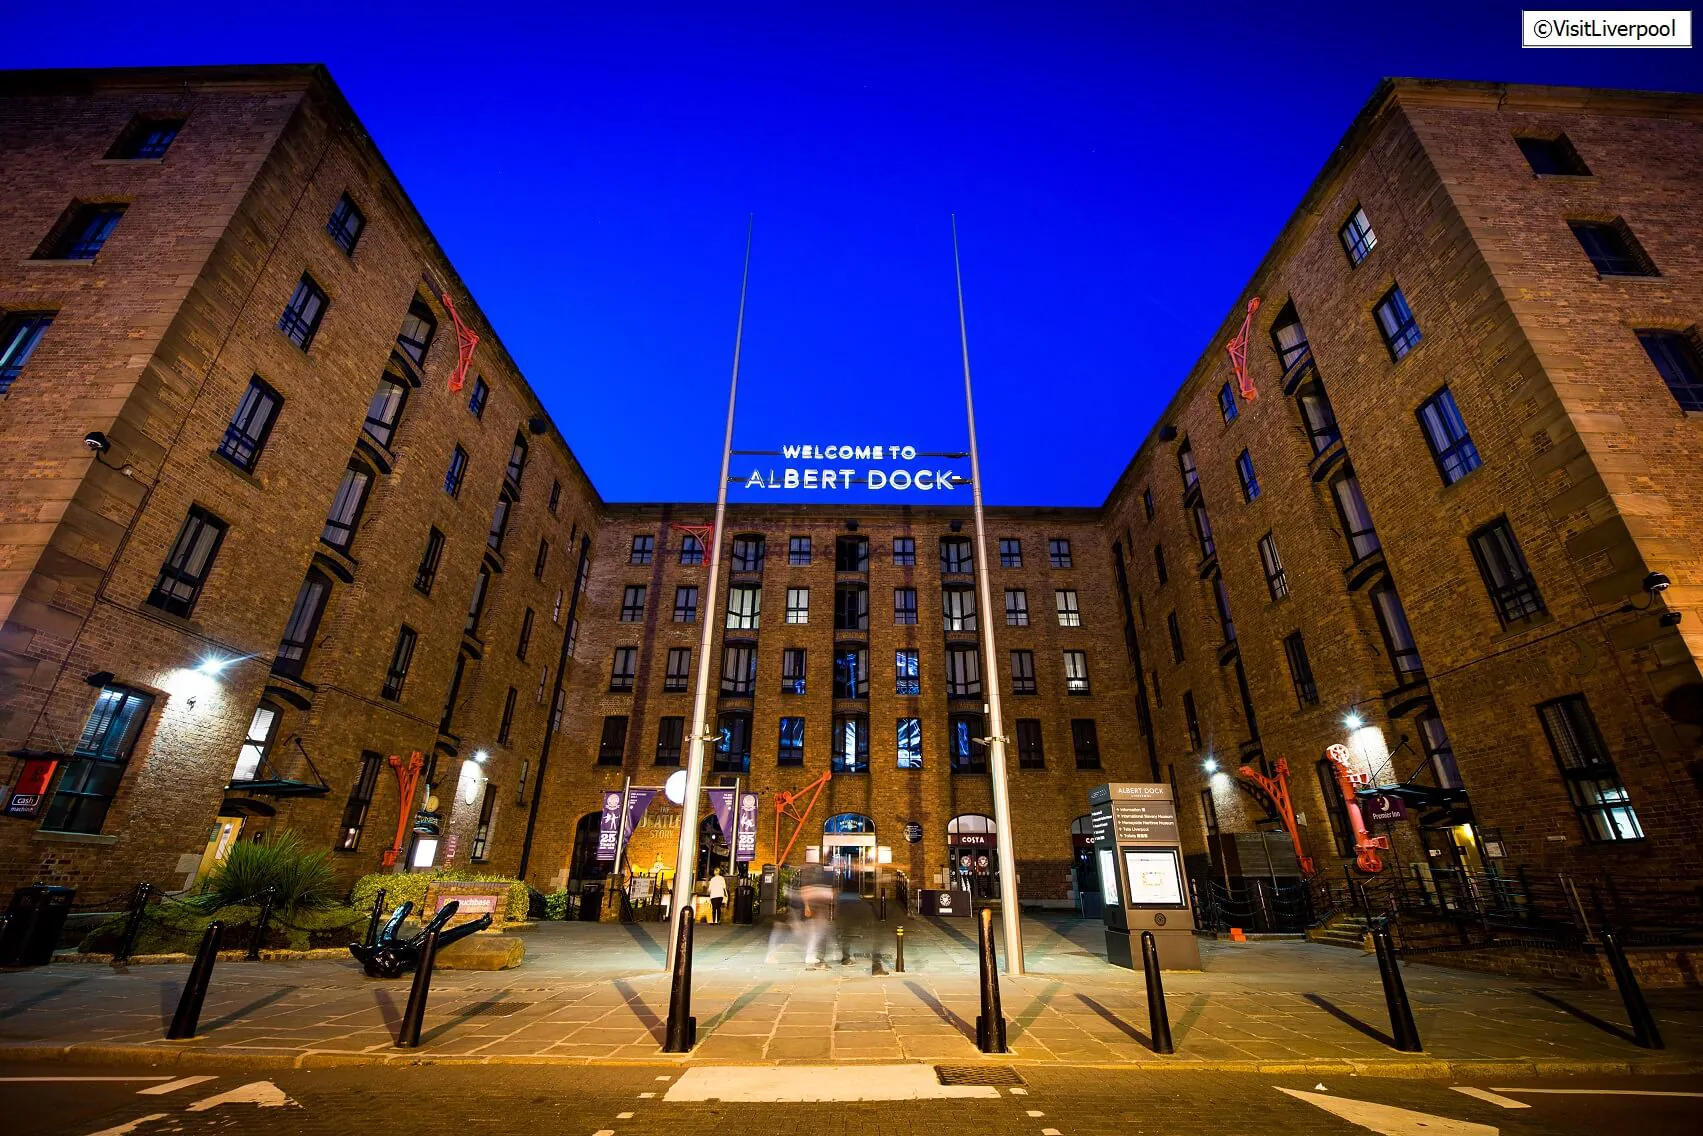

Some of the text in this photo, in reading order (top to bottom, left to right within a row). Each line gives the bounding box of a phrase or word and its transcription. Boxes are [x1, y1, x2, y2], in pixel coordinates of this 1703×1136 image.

[783, 445, 917, 461] WELCOME TO
[744, 468, 956, 491] ALBERT DOCK
[1372, 812, 1392, 820] Premier
[600, 833, 616, 843] 25
[649, 829, 674, 839] STORY
[961, 836, 985, 844] COSTA
